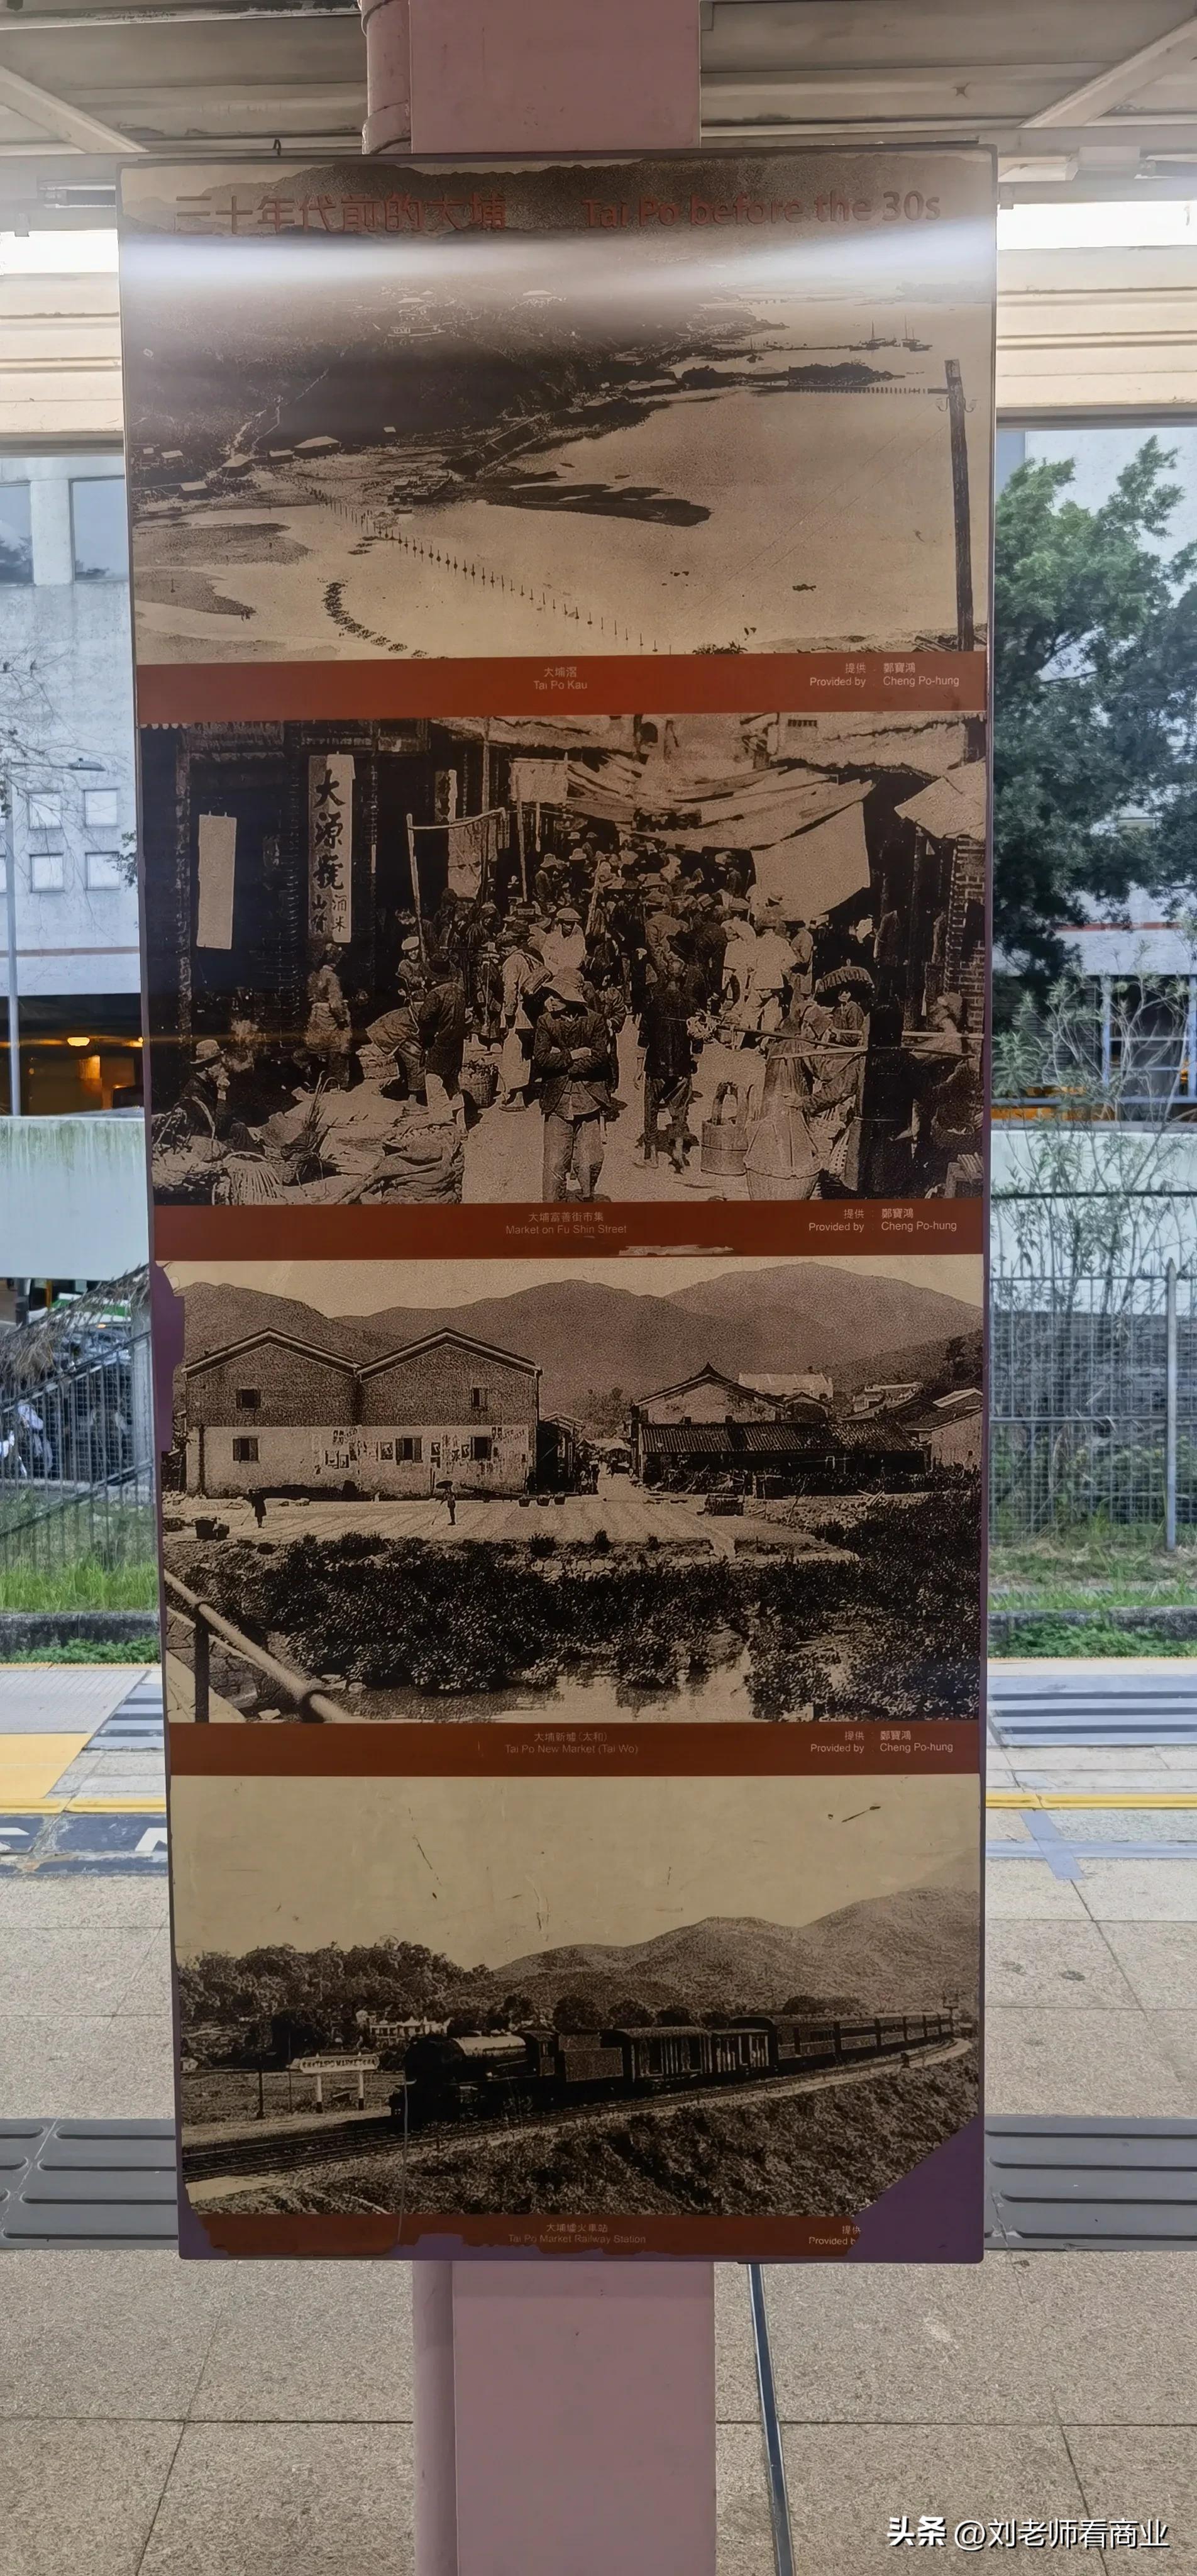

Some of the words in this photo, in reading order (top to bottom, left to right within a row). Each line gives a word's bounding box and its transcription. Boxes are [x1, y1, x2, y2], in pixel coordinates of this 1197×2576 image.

[175, 192, 505, 235] 三十年代前的大埔
[582, 199, 627, 228] Tai
[639, 197, 680, 226] Po
[690, 193, 803, 225] before
[815, 191, 873, 223] the
[881, 190, 941, 221] 30s
[845, 662, 866, 674] 提供
[533, 680, 548, 690] Tai
[551, 680, 565, 690] Po
[567, 679, 588, 690] Kau
[810, 677, 851, 686] Provided
[854, 677, 866, 687] by
[883, 675, 915, 687] Cheng
[918, 675, 959, 687] Po-hung
[528, 1211, 604, 1223] 大埔富善街市集
[843, 1209, 864, 1219] 提供
[881, 1208, 913, 1219] 鄭寶鴻
[506, 1225, 539, 1234] Market
[558, 1225, 570, 1234] Fu
[573, 1224, 594, 1234] Shin
[598, 1224, 627, 1233] Street
[808, 1223, 850, 1231] Provided
[853, 1223, 864, 1233] by
[881, 1221, 913, 1232] Cheng
[917, 1221, 957, 1232] Po-hung
[845, 1731, 864, 1741] 提供
[505, 1744, 519, 1753] Tai
[522, 1744, 535, 1753] Po
[538, 1745, 558, 1753] New
[562, 1744, 595, 1753] Market
[598, 1743, 615, 1754] (Tai
[618, 1743, 639, 1754] Wo)
[810, 1743, 851, 1752] Provided
[854, 1743, 864, 1753] by
[880, 1743, 911, 1753] Cheng
[913, 1742, 954, 1753] Po-hung
[509, 2235, 521, 2243] Tai
[524, 2235, 537, 2243] Po
[540, 2235, 571, 2243] Market
[575, 2235, 610, 2244] Railway
[614, 2234, 646, 2243] Station
[808, 2236, 848, 2245] Provided
